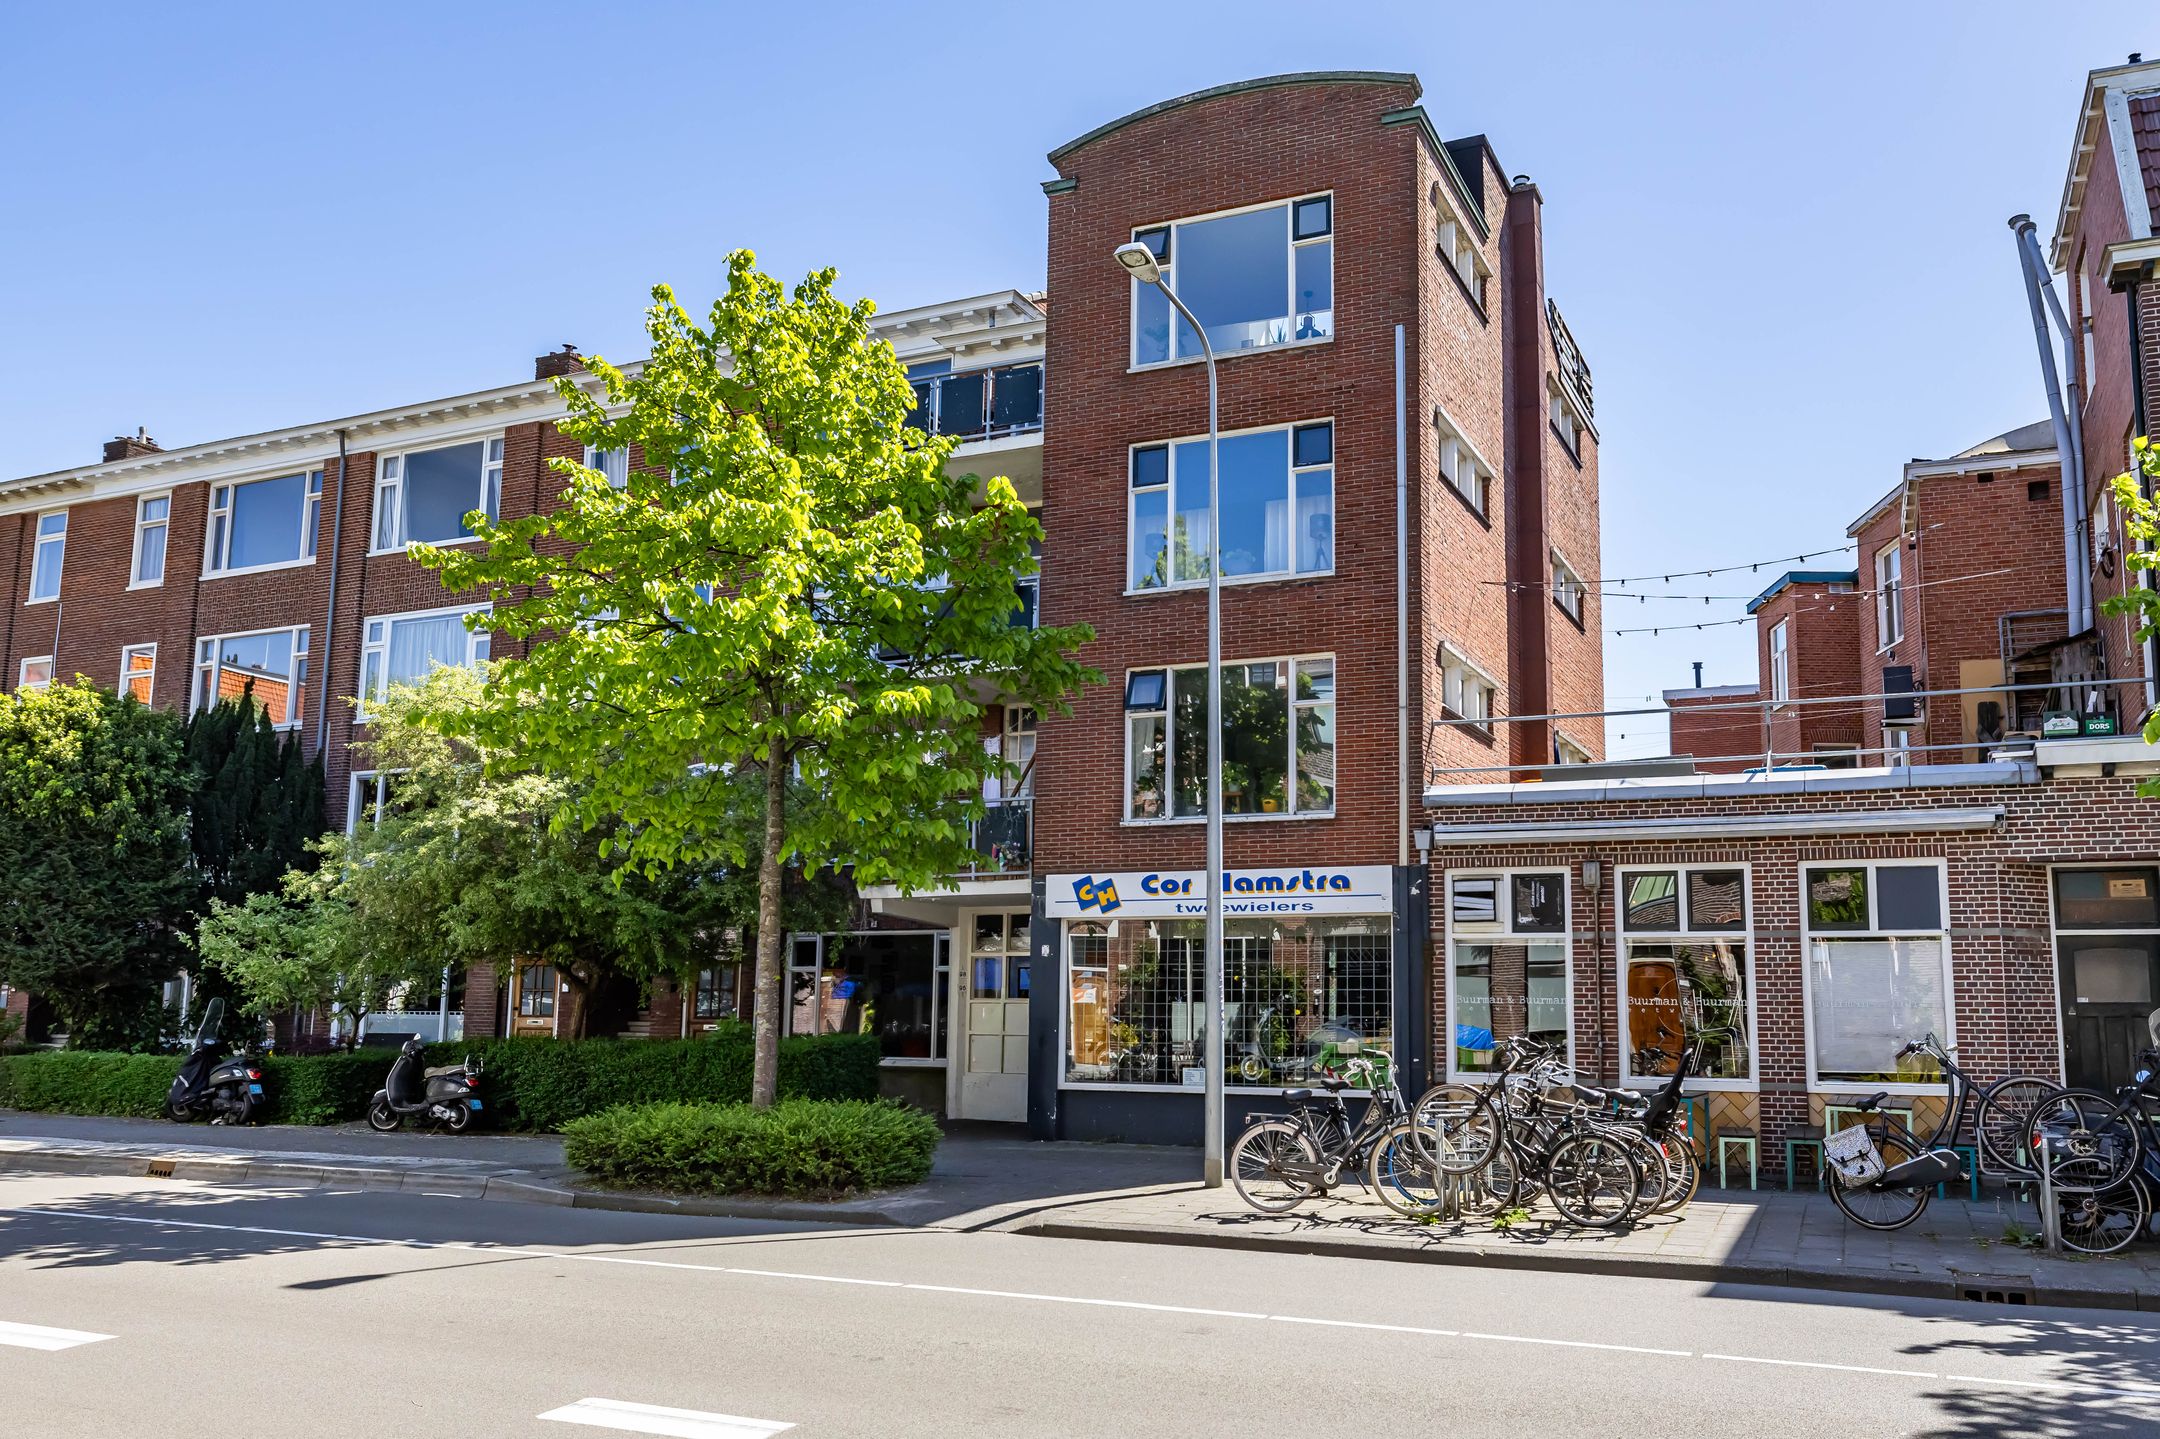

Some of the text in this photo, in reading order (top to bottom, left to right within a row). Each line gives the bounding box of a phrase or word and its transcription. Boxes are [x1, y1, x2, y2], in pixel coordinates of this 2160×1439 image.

[1141, 874, 1193, 896] Cor
[1456, 995, 1504, 1004] Buurman
[1507, 995, 1516, 1004] &
[1628, 996, 1679, 1006] Buurman
[1682, 997, 1691, 1006] &
